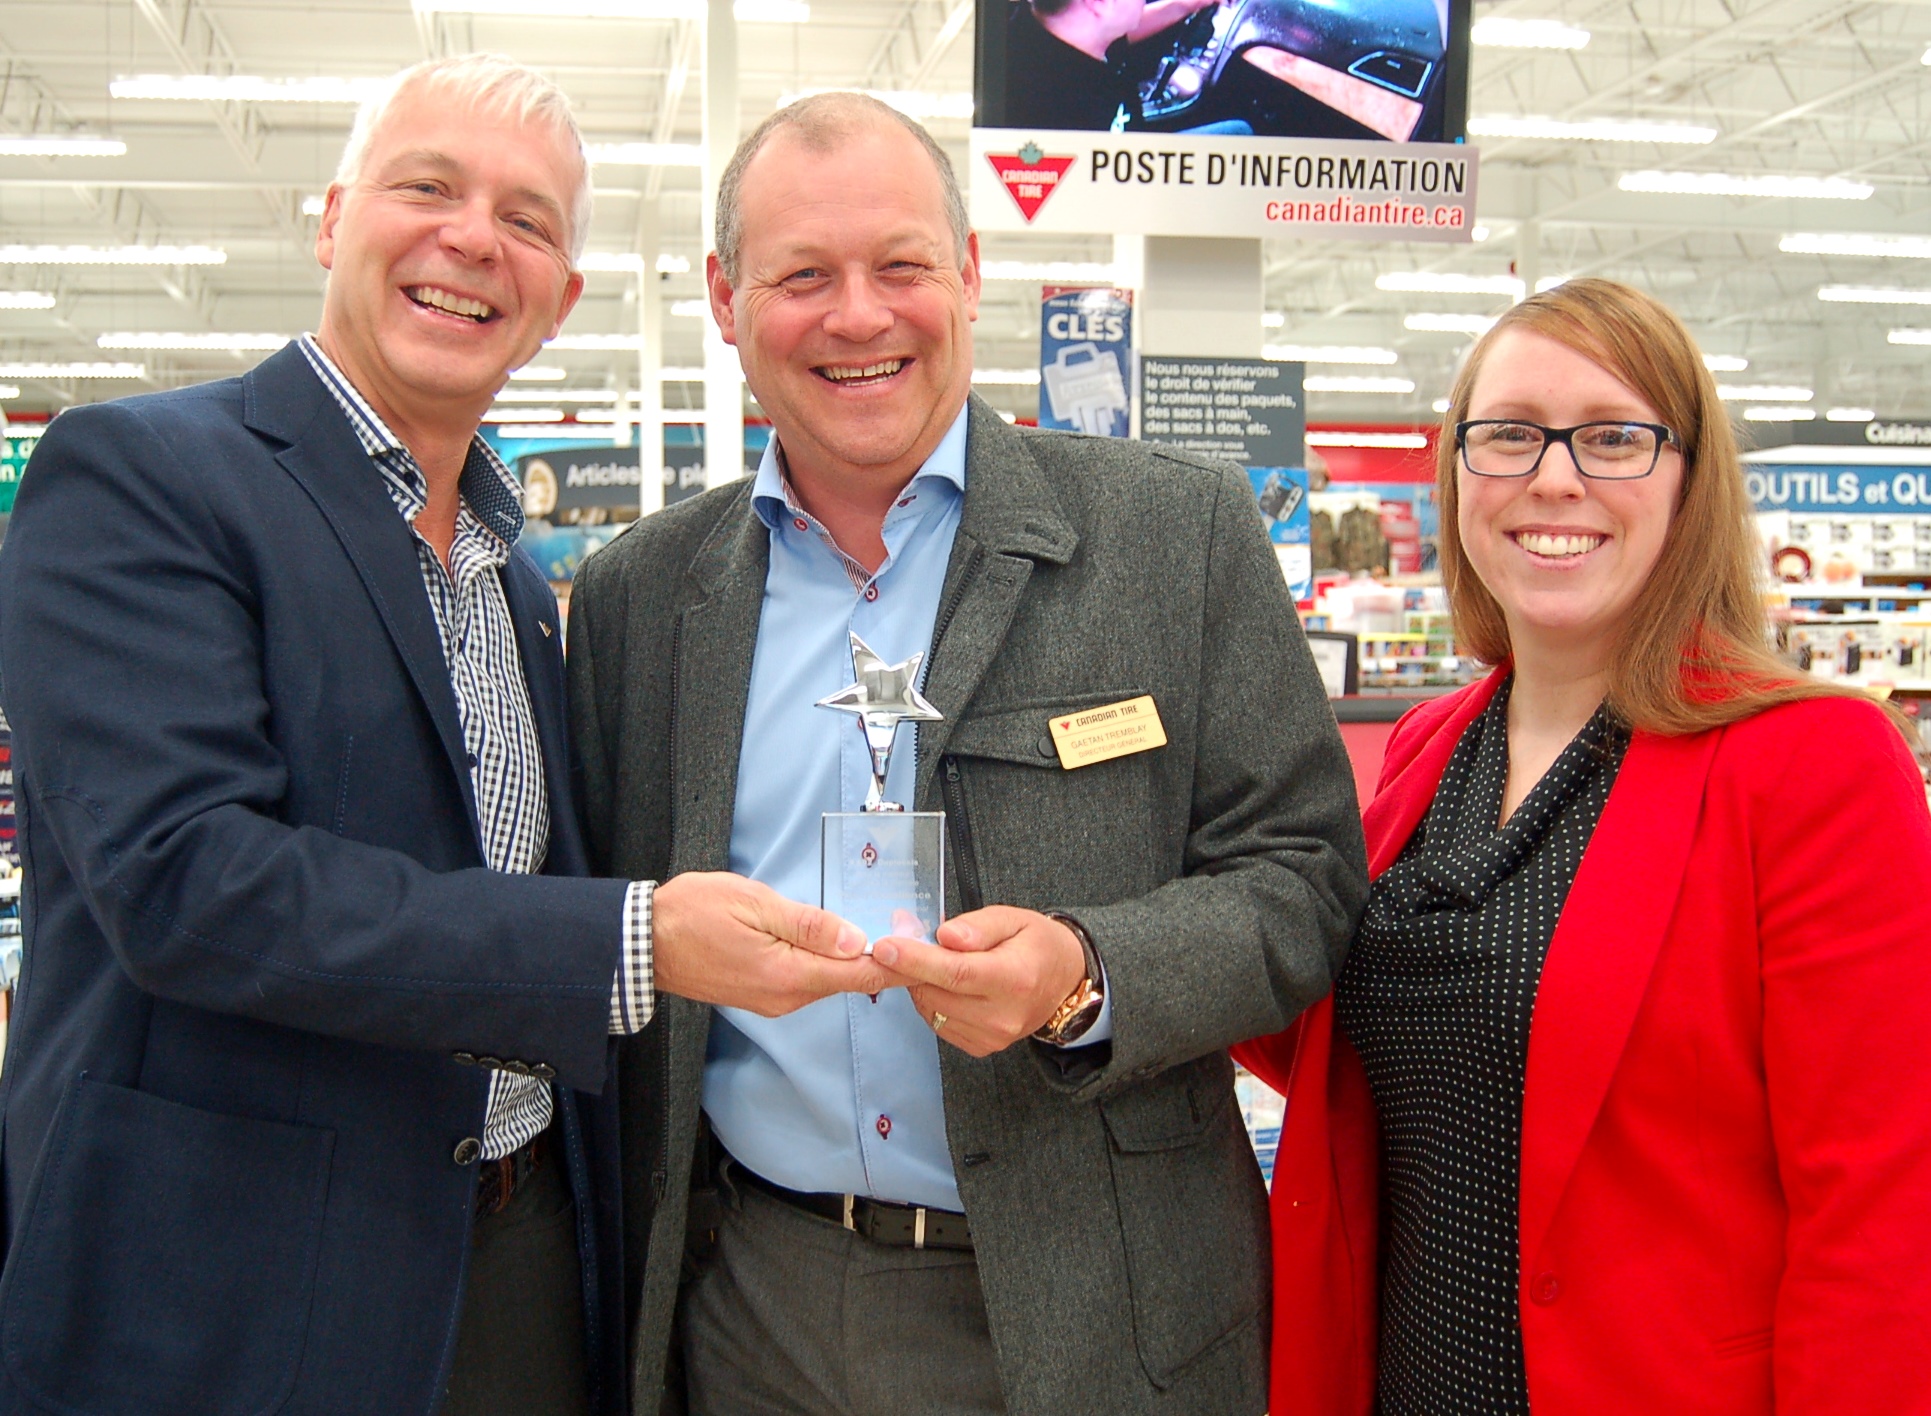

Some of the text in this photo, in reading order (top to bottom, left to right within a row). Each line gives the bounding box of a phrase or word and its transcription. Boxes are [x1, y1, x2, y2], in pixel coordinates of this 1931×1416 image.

[1002, 169, 1059, 184] CANADIAN
[1092, 150, 1466, 194] POSTE D'INFORMATION
[1018, 184, 1043, 198] TIRE
[1266, 197, 1464, 226] canadiantire.ca
[1145, 361, 1279, 378] Nous nous réservons
[1145, 376, 1256, 391] le droit de vérifier
[1145, 391, 1296, 409] le contenu des paquets,
[1145, 405, 1251, 421] des sacs à main,
[1145, 420, 1271, 436] des sacs à dos, etc.
[1745, 472, 1860, 505] OUTILS
[1863, 480, 1889, 505] et
[1076, 705, 1138, 727] CANADIAN TIRE
[1105, 724, 1147, 740] TREMBLAY
[1079, 743, 1116, 758] DIRECTEUR
